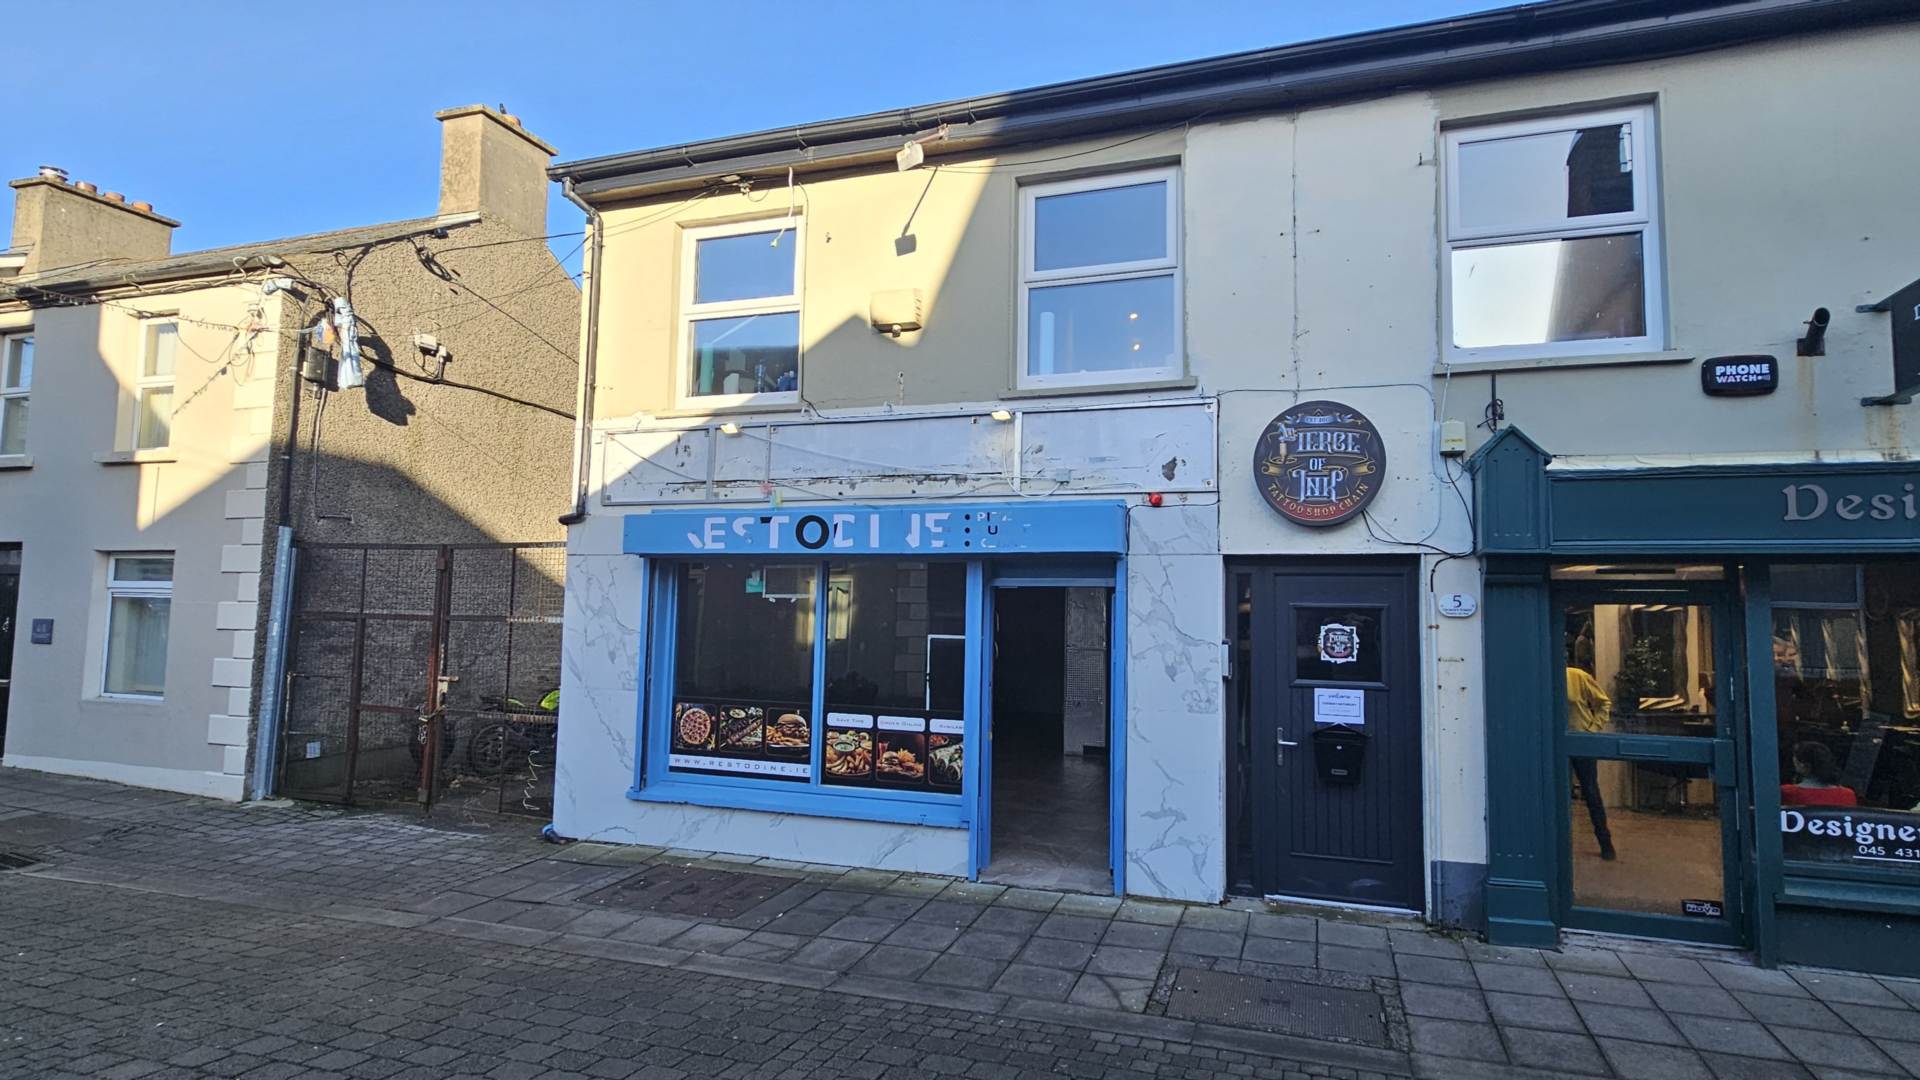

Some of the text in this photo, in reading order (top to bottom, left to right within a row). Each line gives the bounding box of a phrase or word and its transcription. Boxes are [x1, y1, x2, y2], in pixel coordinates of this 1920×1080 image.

[1716, 364, 1769, 375] PHONE
[1716, 375, 1757, 383] WATCH
[1309, 458, 1326, 470] OF
[1292, 470, 1344, 503] INK
[1268, 483, 1369, 516] TATTOO SHOP CHAIN
[1453, 595, 1462, 608] 5
[1781, 811, 1920, 845] Designe
[1858, 845, 1886, 856] 045
